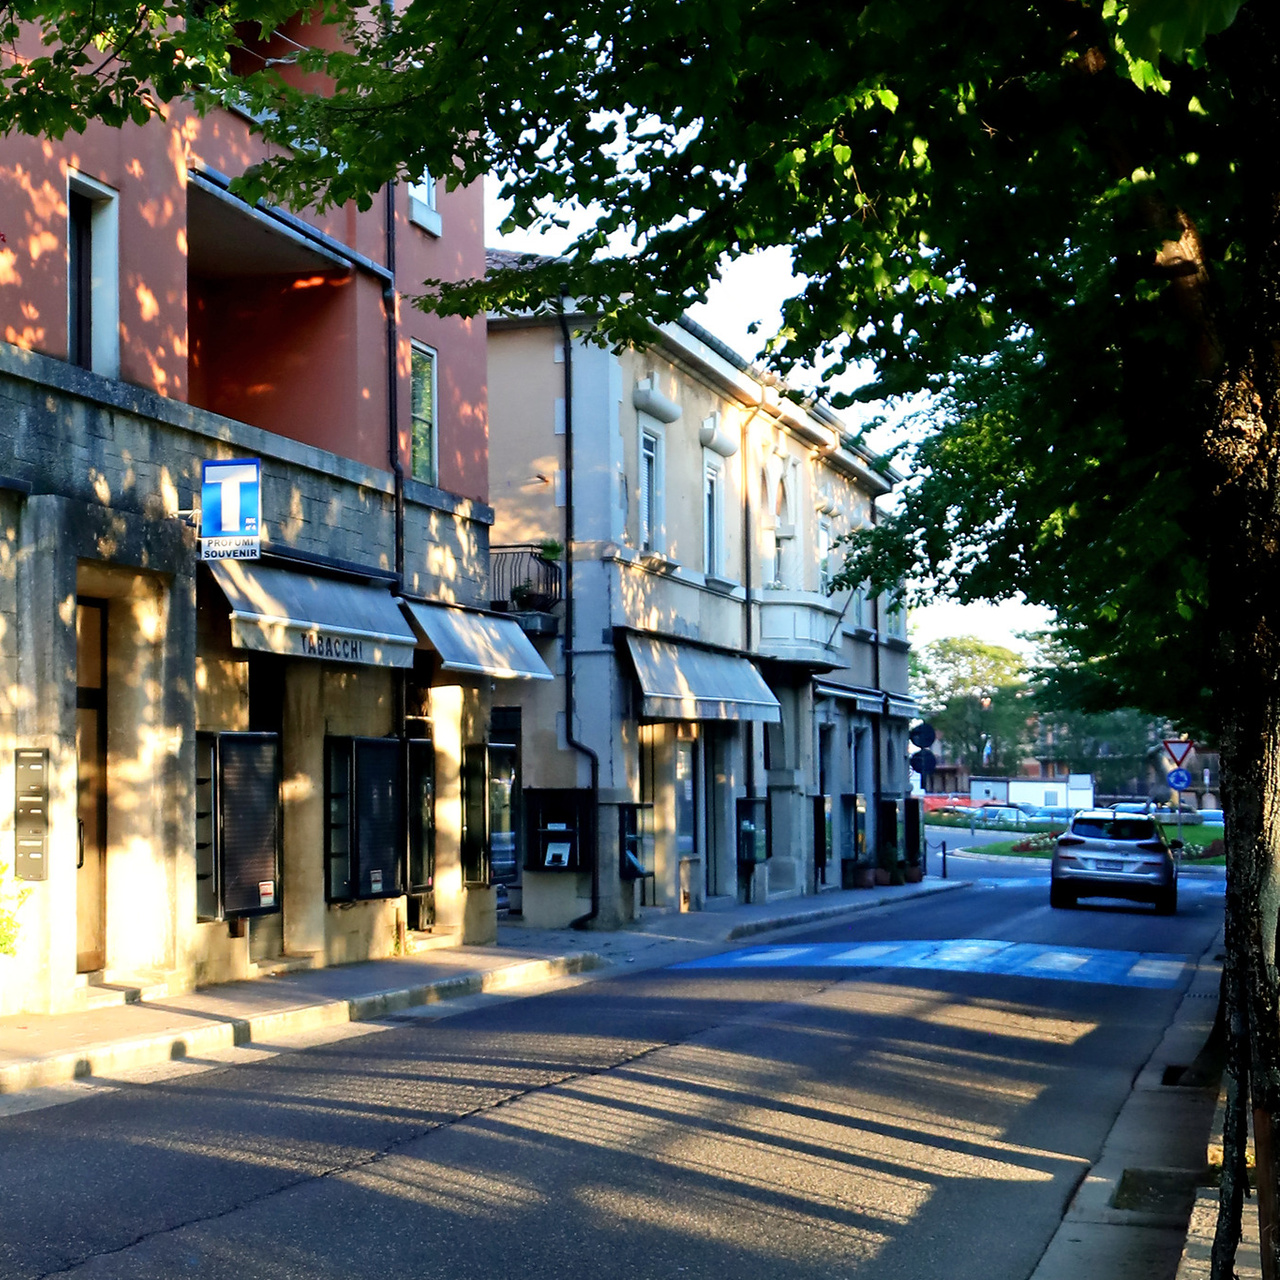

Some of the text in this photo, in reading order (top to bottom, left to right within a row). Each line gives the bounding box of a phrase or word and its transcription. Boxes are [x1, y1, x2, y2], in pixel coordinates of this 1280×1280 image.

[204, 464, 258, 532] T
[207, 538, 254, 548] PROFUMI
[204, 548, 258, 559] SOUVENIR
[301, 631, 363, 660] TABACCHI
